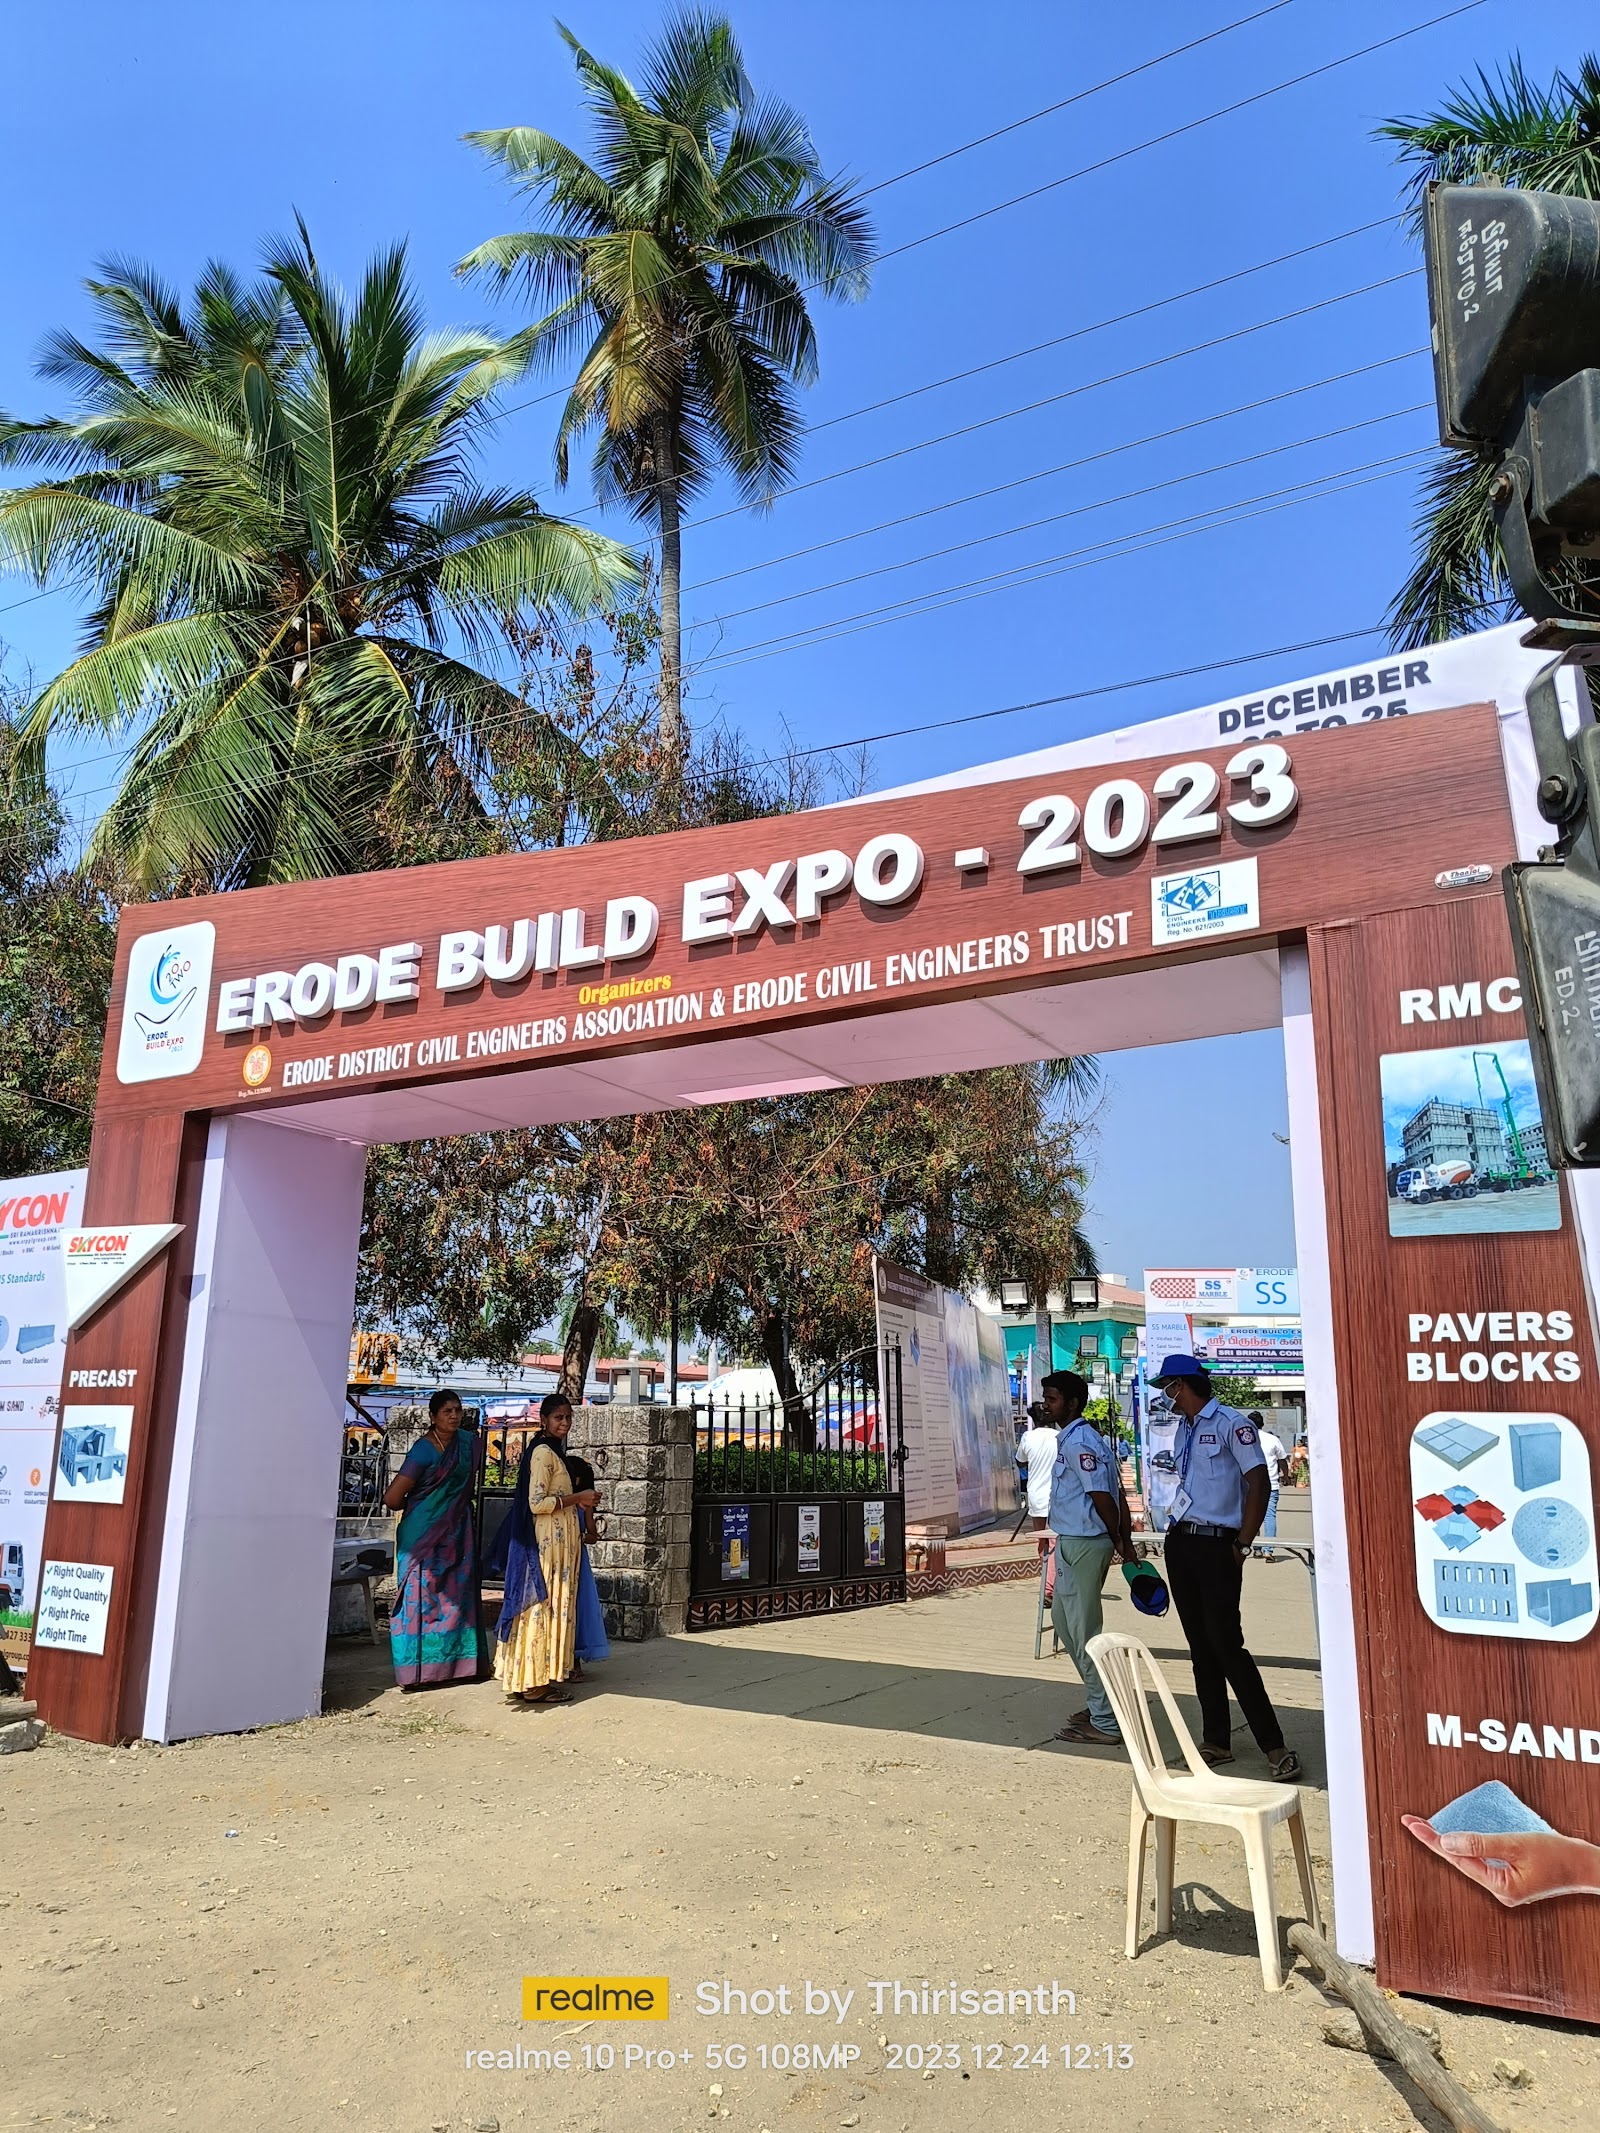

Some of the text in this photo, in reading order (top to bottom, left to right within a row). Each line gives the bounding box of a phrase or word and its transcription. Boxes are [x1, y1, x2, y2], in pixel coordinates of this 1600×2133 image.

[1219, 660, 1431, 735] DECEMBER
[216, 744, 1299, 1035] ERODE BUILD EXPO - 2023
[1167, 916, 1184, 924] CIVIL
[1167, 917, 1207, 928] ENGINEERS
[282, 911, 1133, 1087] ERODE DISTRICT CIVIL ENGINEERS ASSOCIATION & ERODE CIVIL ENGINEERS TRUST
[578, 975, 671, 1005] Organizers
[1400, 977, 1523, 1024] RMC
[146, 1037, 184, 1050] BUILD EXPO
[147, 1031, 168, 1041] ERODE
[0, 1192, 70, 1231] YCON
[69, 1236, 129, 1253] SKYCON
[7, 1270, 46, 1284] Standards
[1256, 1268, 1294, 1276] ERODE
[1204, 1280, 1222, 1290] SS
[1255, 1281, 1287, 1305] SS
[1151, 1323, 1188, 1331] SS MARBLE
[1408, 1311, 1574, 1342] PAVERS
[1235, 1349, 1278, 1357] BRINTHA
[1407, 1351, 1581, 1382] BLOCKS
[68, 1370, 138, 1388] PRECAST
[53, 1565, 105, 1583] Right Quality
[50, 1586, 108, 1605] Right Quantity
[48, 1606, 90, 1622] Right Price
[45, 1627, 87, 1643] Right Time
[1426, 1712, 1600, 1764] M-SAND
